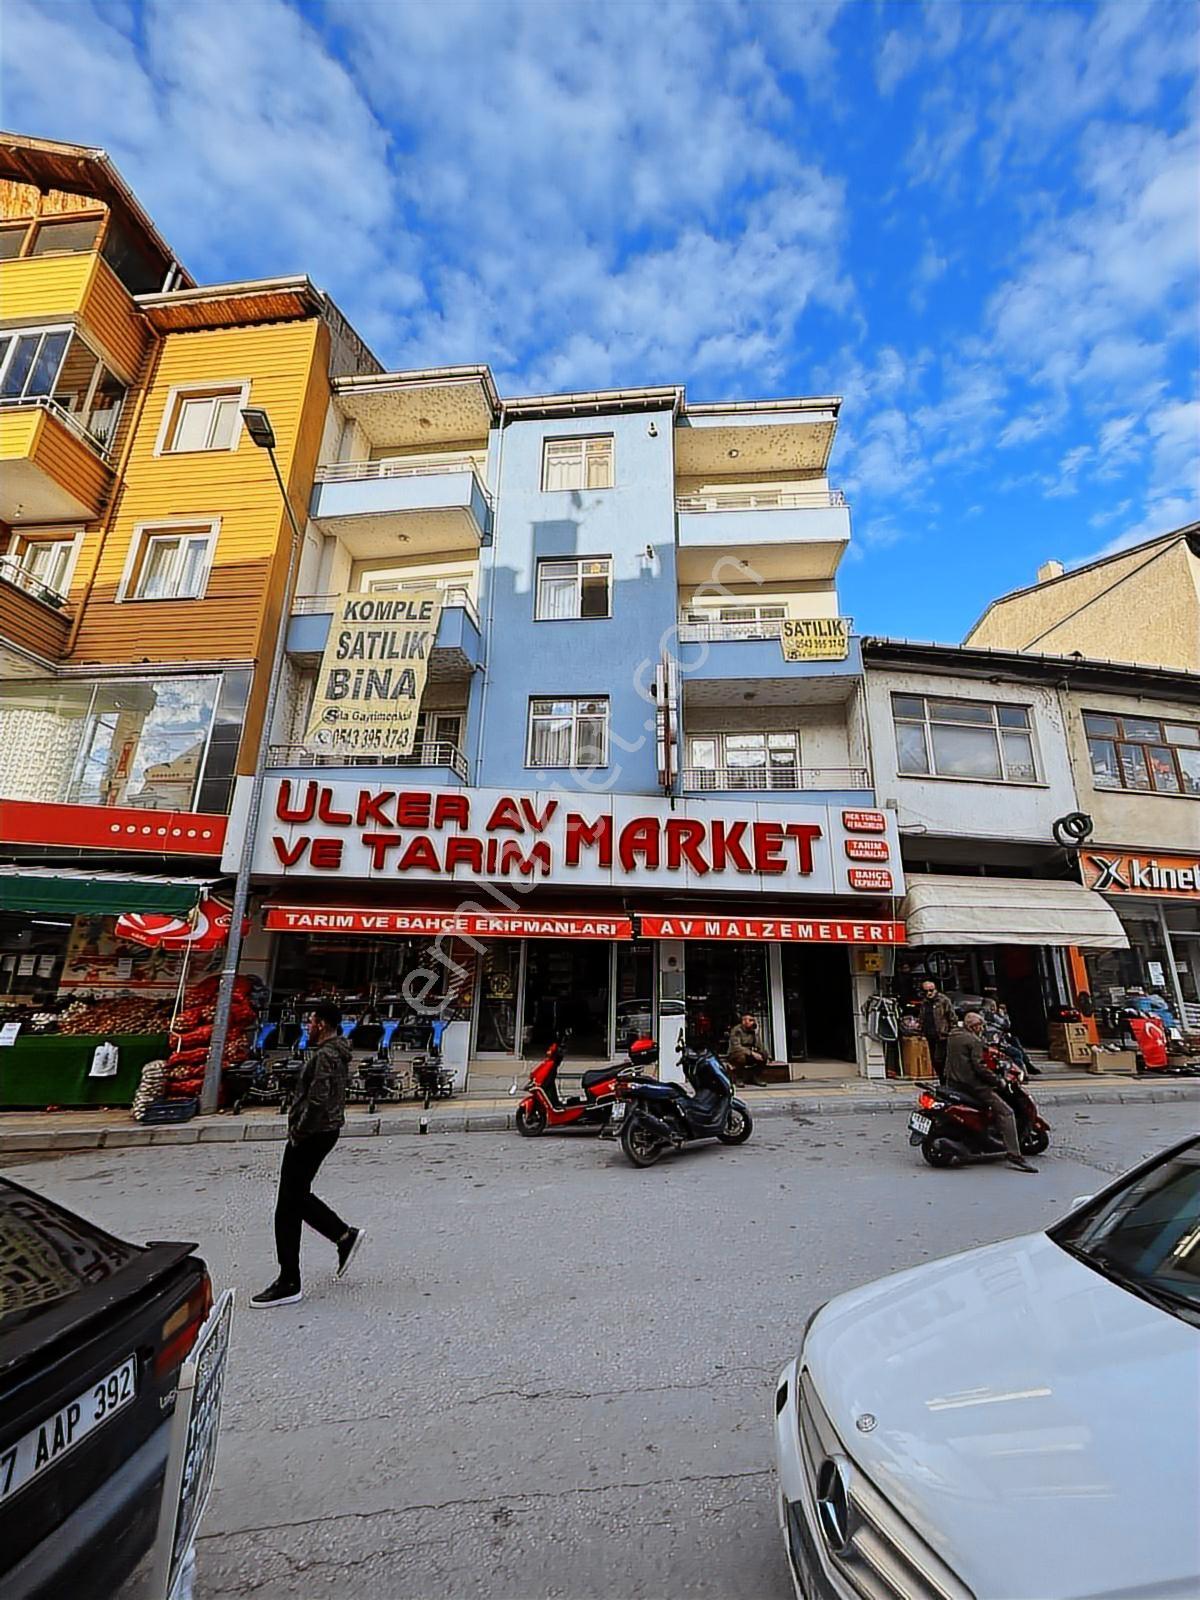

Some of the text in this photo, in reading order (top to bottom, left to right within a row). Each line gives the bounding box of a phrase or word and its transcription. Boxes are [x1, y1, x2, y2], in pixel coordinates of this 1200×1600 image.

[343, 600, 433, 621] KOMPLE
[784, 620, 844, 637] SATILIK
[336, 631, 429, 660] SATILIK
[276, 779, 558, 832] ÜLKER AV
[273, 833, 552, 876] VE TARIM
[565, 813, 823, 876] MARKET
[853, 841, 882, 849] TARIM
[855, 871, 888, 880] BAHÇE
[286, 913, 353, 928] TARIM
[361, 917, 390, 929] VE
[396, 917, 468, 934] BAHÇE
[660, 920, 694, 935] AV
[35, 1403, 81, 1471] AAP
[94, 1366, 131, 1420] 392
